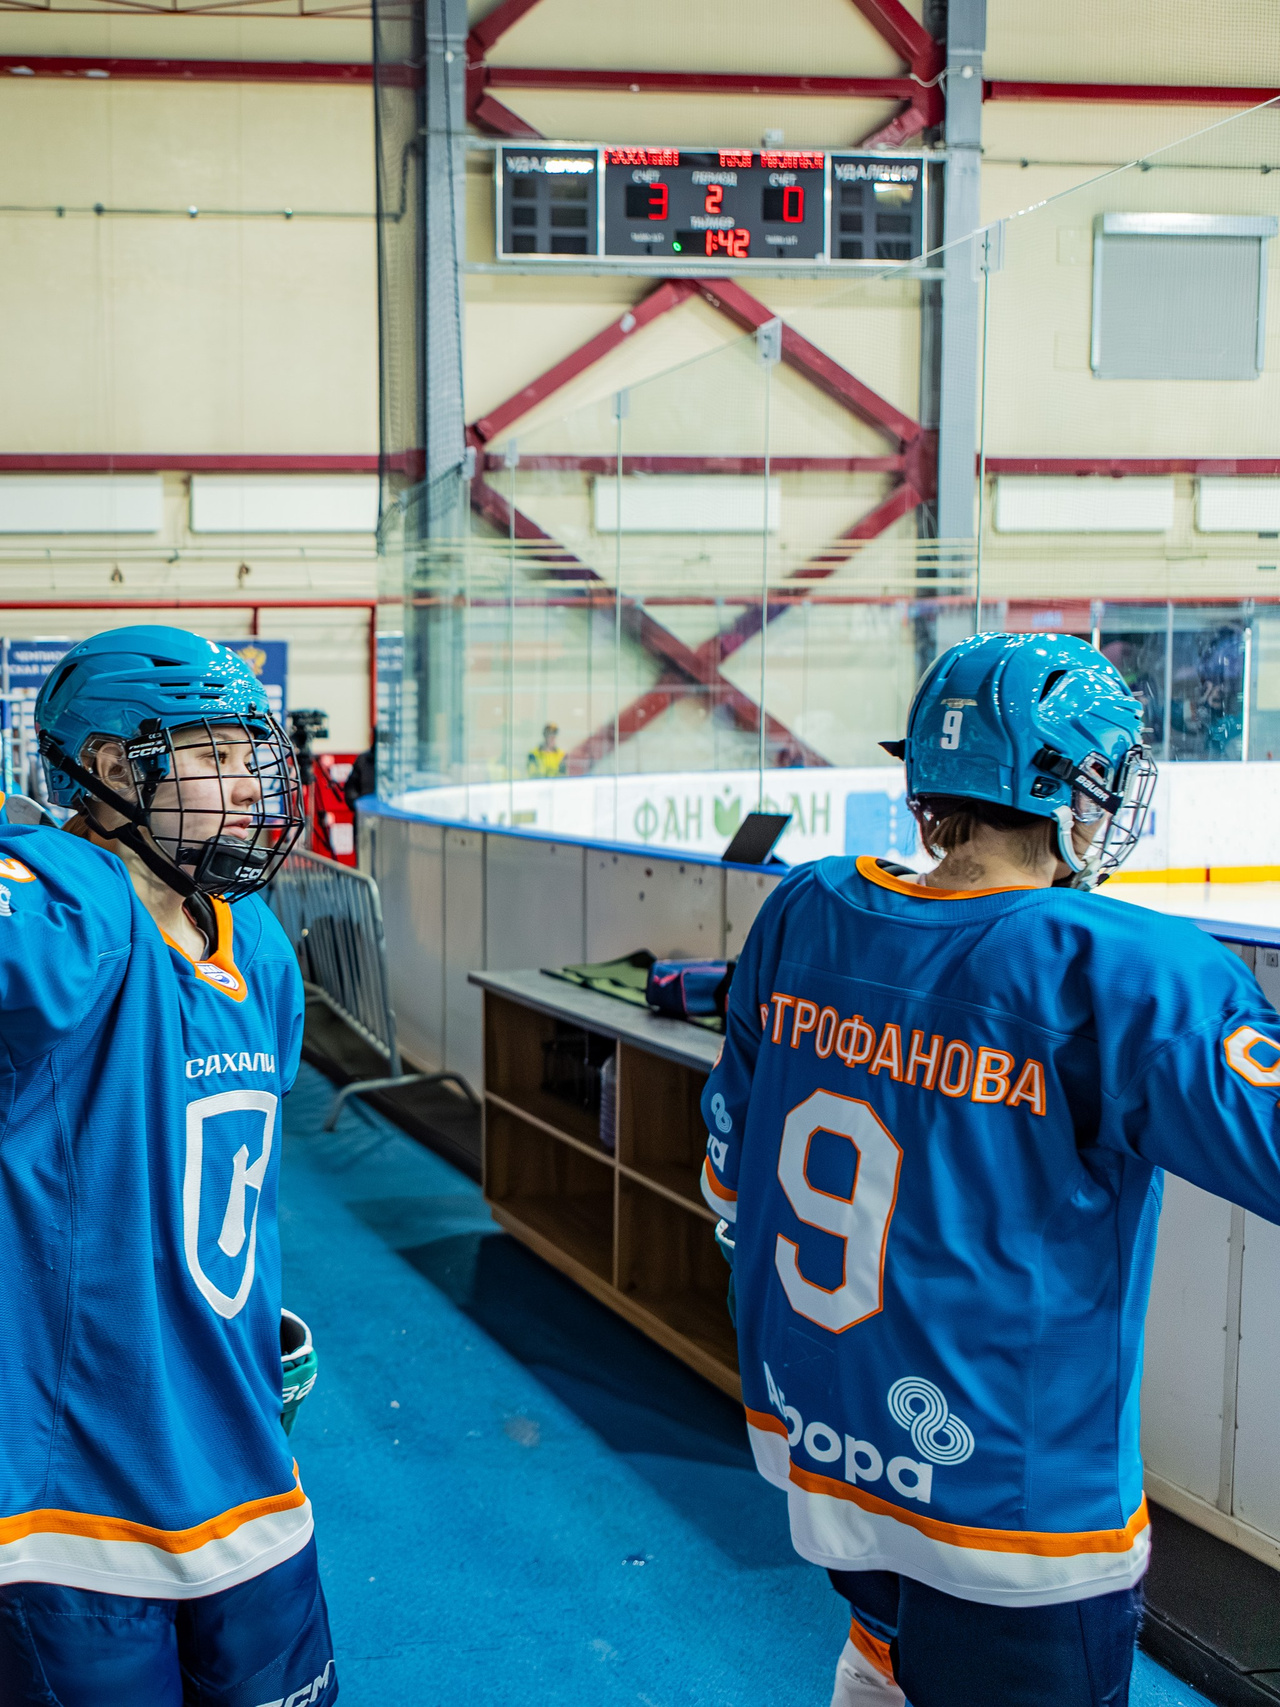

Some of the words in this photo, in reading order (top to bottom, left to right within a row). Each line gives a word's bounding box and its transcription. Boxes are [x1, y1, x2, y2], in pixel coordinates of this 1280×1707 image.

[506, 156, 595, 174] УДАЛ
[648, 183, 669, 220] 3
[705, 184, 723, 214] 2
[783, 186, 804, 223] 0
[705, 228, 750, 258] 1:42
[940, 710, 963, 750] 9
[128, 745, 167, 759] CCM
[634, 796, 703, 843] ФАН
[185, 1052, 276, 1079] САХАЛИ
[774, 1087, 904, 1335] 9
